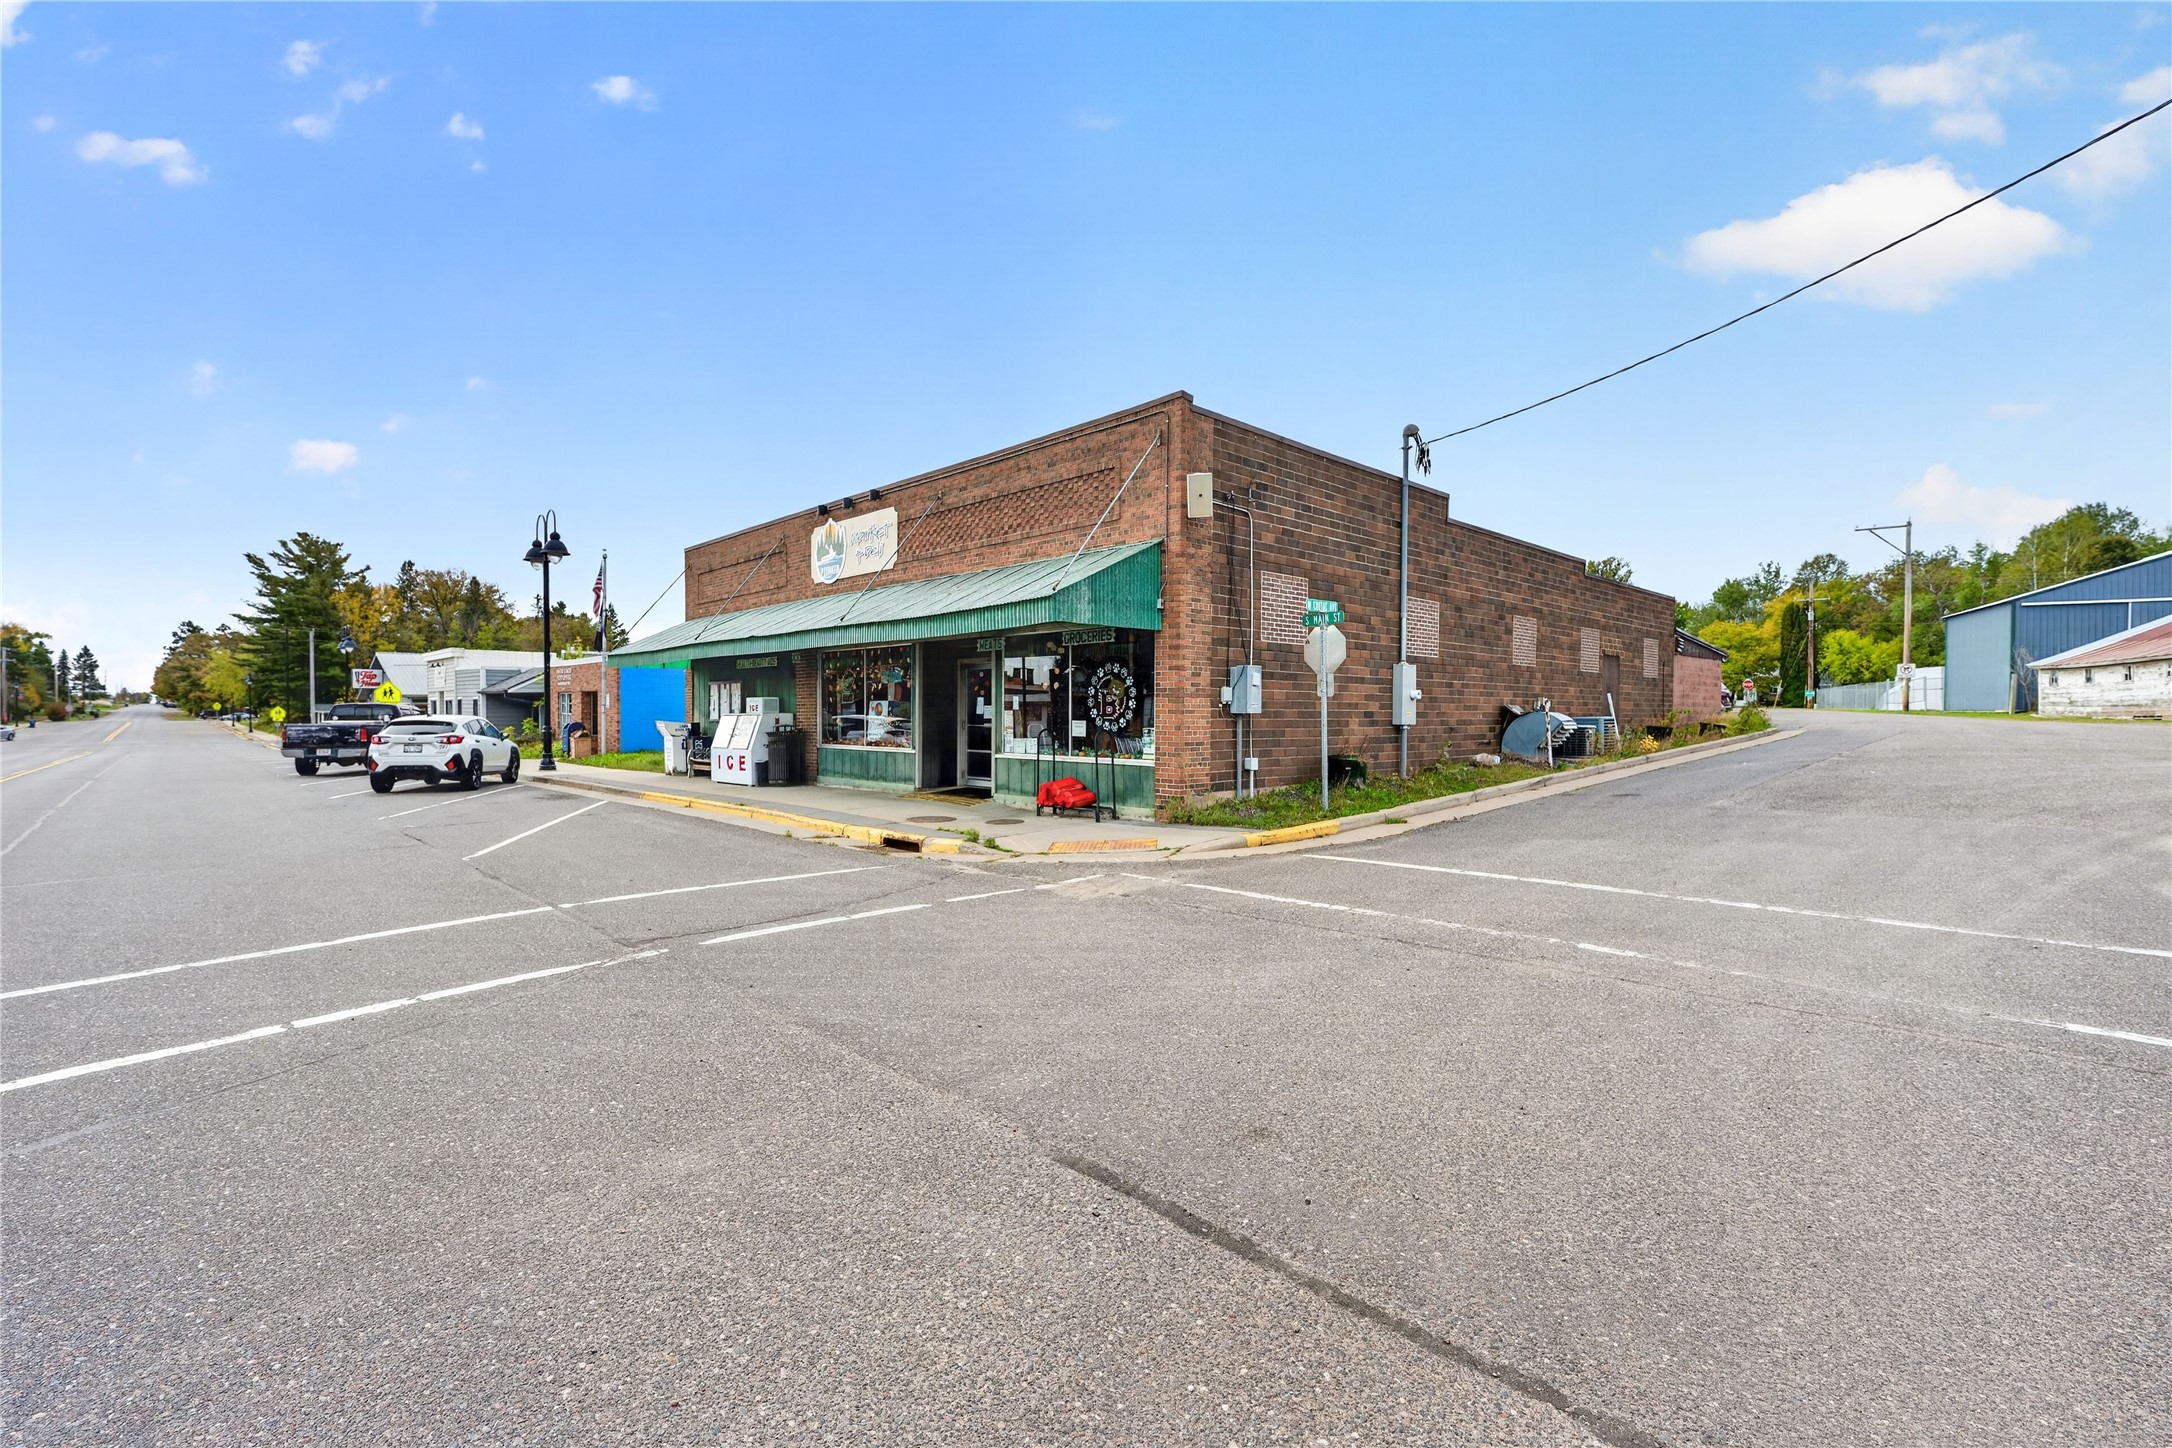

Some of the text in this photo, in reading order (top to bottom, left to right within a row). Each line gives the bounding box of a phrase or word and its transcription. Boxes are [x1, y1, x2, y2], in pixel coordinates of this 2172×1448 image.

[1305, 613, 1340, 625] S MAIN ST
[1063, 628, 1113, 645] GROCERIES
[979, 638, 1003, 651] MEATS
[749, 704, 759, 712] ICE
[717, 754, 747, 772] ICE
